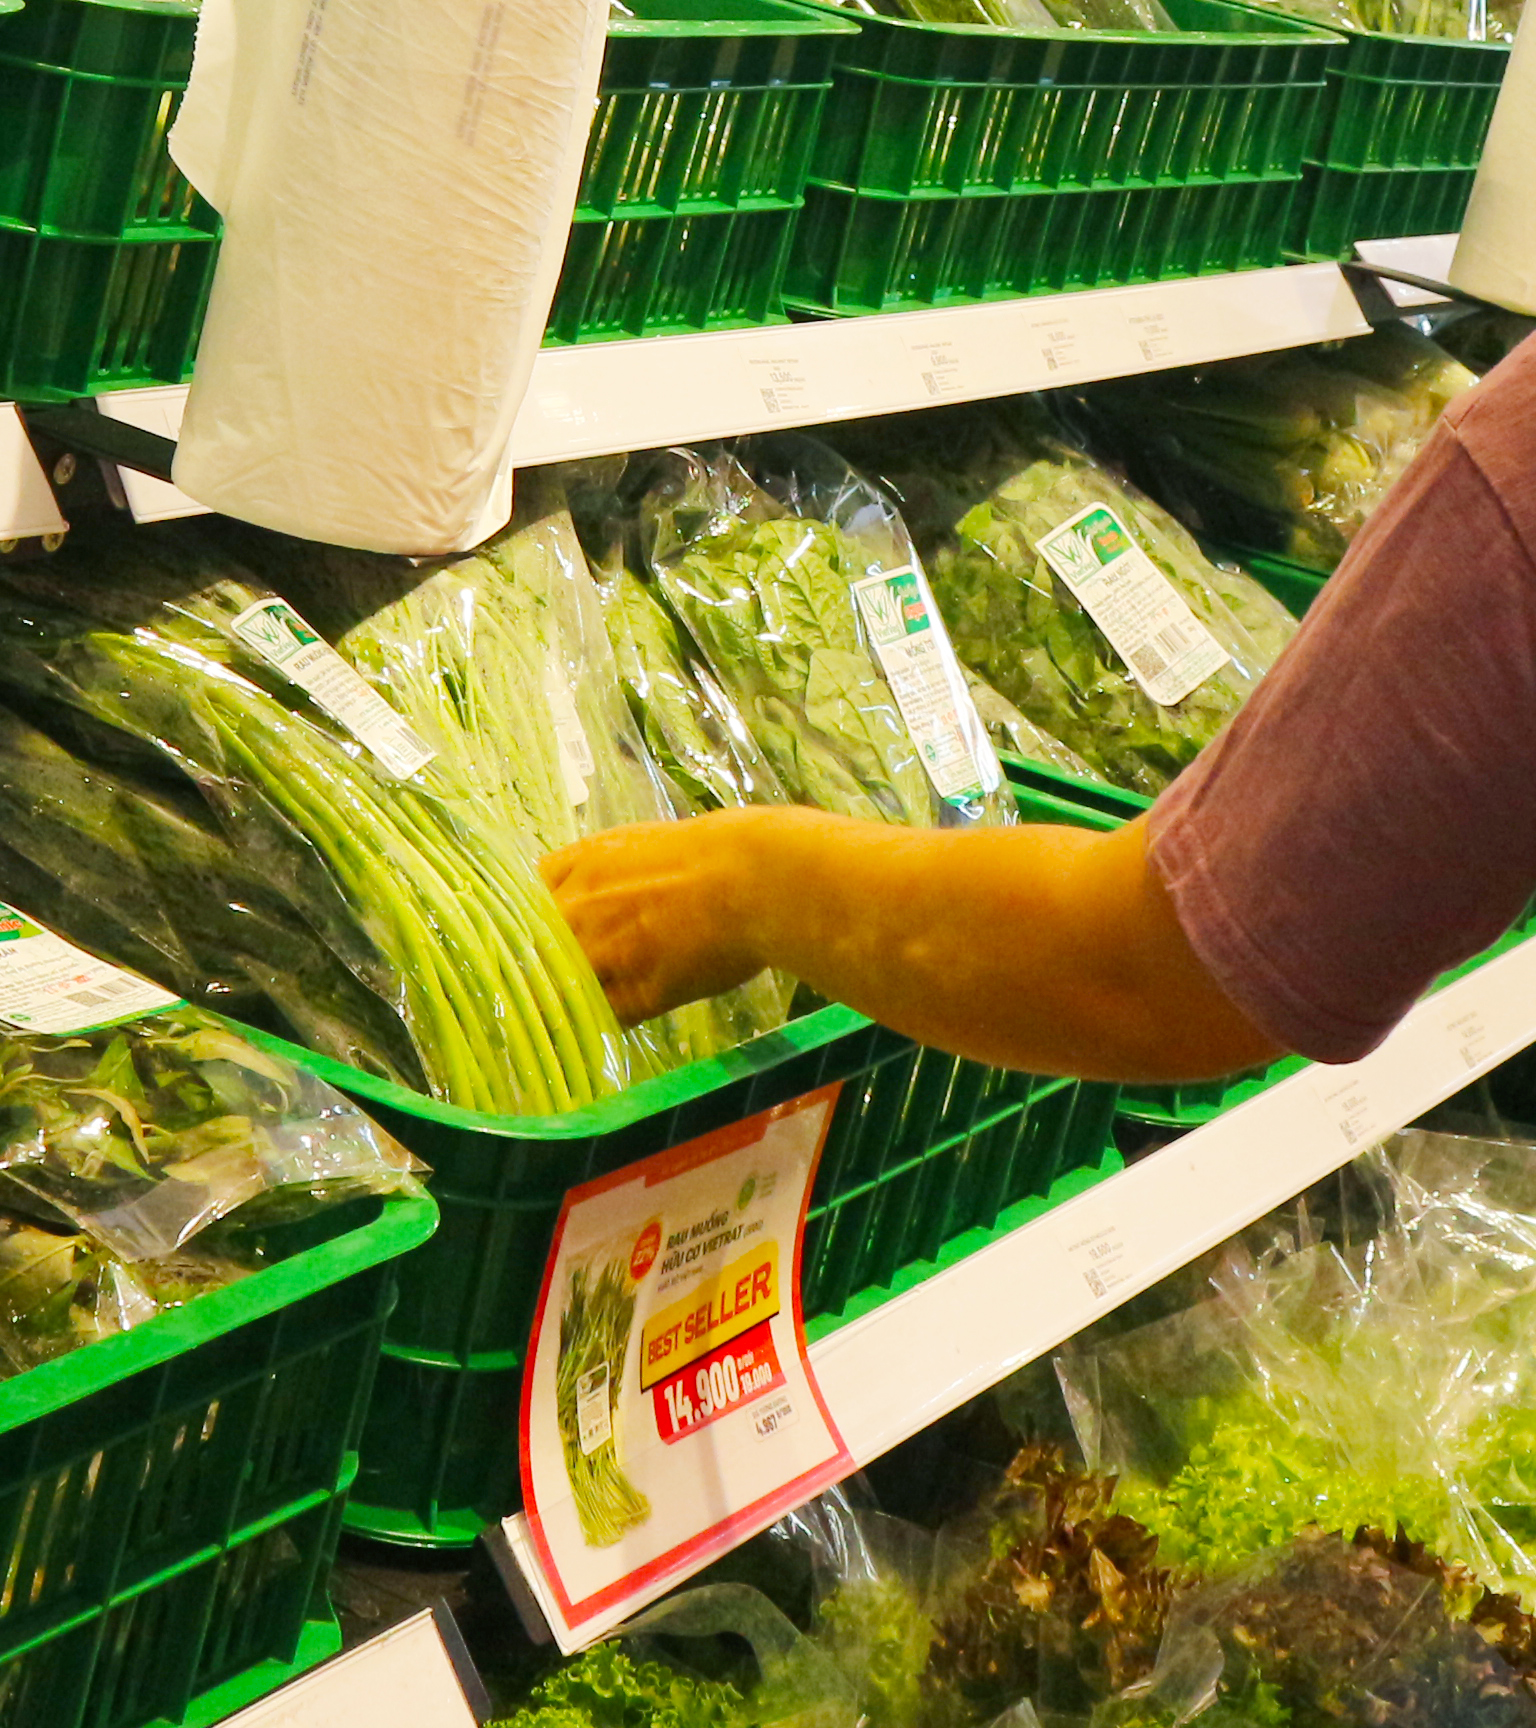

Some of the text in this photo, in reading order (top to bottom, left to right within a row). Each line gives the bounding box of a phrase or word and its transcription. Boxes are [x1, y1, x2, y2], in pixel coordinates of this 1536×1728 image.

[666, 1227, 689, 1251] RAU
[702, 1224, 744, 1255] VIETRAT
[648, 1322, 682, 1366] BEST
[684, 1261, 772, 1344] SELLER
[664, 1355, 740, 1433] 14.900
